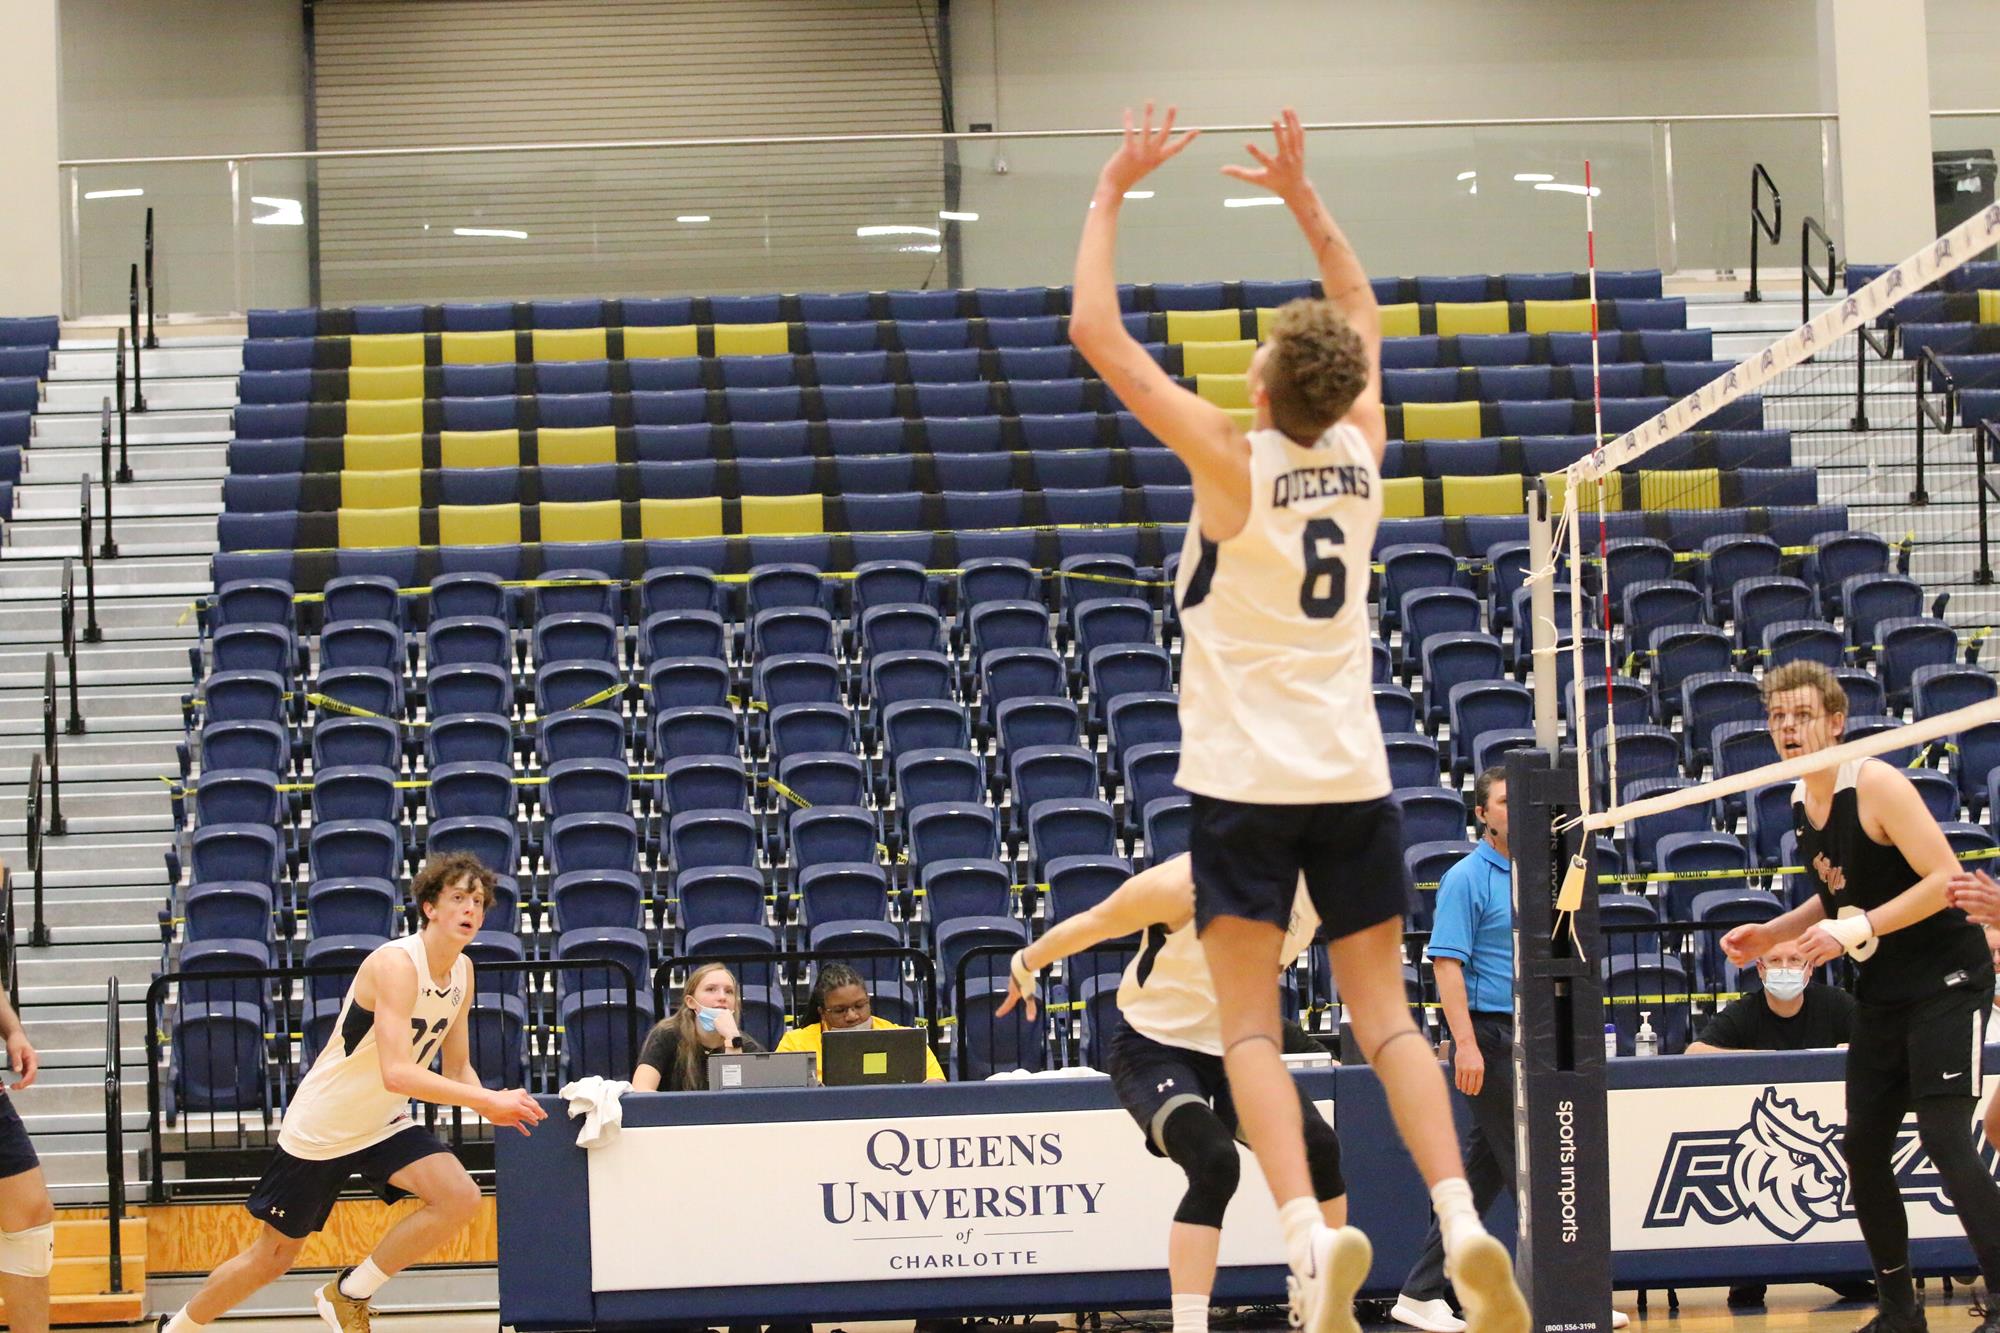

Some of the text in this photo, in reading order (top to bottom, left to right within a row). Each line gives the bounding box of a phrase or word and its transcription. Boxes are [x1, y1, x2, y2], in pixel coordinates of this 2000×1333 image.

[1272, 466, 1371, 508] QUEENS
[1300, 518, 1347, 619] 6
[866, 1128, 1063, 1176] QUEENS
[1556, 1100, 1579, 1243] sports imports
[818, 1181, 1106, 1224] UNIVERSITY
[956, 1228, 974, 1244] of
[889, 1250, 1038, 1270] CHARLOTTE
[1545, 1322, 1597, 1333] (800) 556-3198
